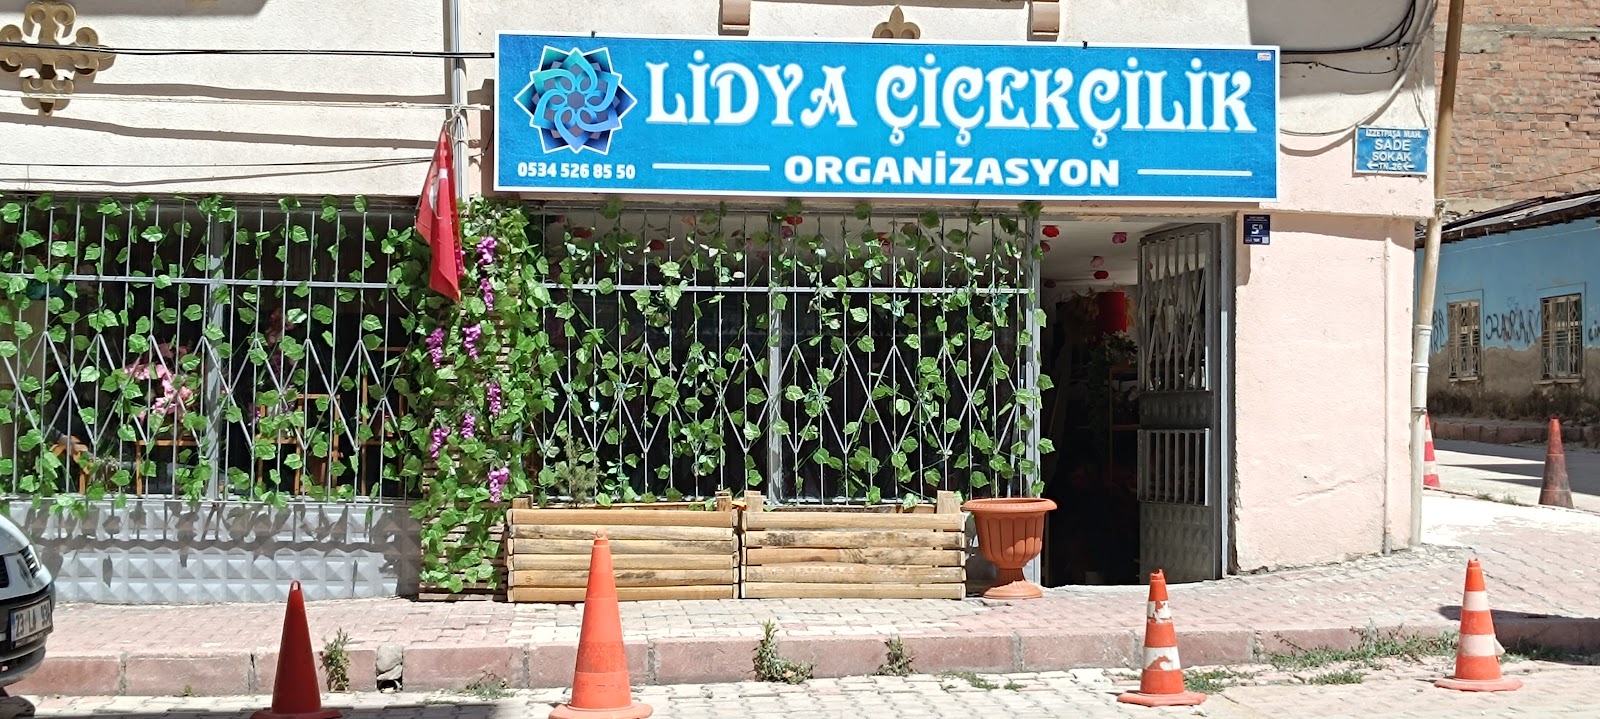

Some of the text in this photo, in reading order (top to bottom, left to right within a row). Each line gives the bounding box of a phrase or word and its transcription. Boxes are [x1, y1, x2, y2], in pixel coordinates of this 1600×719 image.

[645, 49, 1258, 148] LİDYA ÇİÇEKÇİLİK
[1375, 139, 1411, 151] SADE
[1371, 151, 1412, 162] SOKAK
[517, 162, 636, 180] 0534 526 85 50
[784, 151, 1119, 187] ORGANİZASYON
